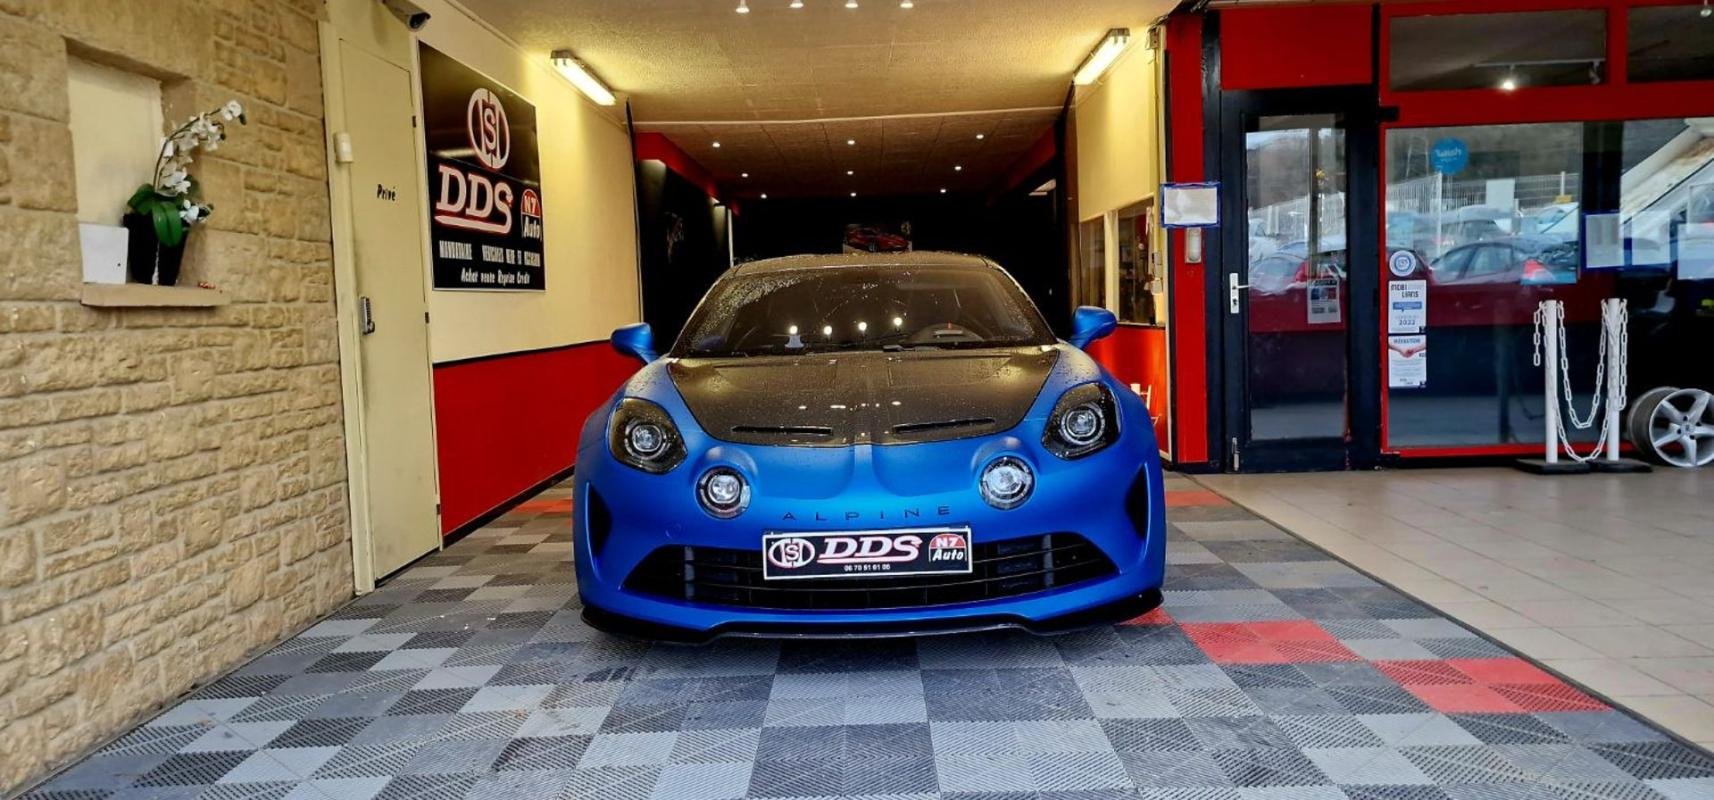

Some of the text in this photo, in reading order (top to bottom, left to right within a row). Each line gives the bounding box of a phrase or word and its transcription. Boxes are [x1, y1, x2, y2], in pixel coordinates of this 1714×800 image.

[376, 183, 396, 202] Privé
[435, 164, 514, 232] DDS
[524, 194, 537, 214] N7
[523, 215, 540, 239] Auto
[782, 505, 951, 521] ALPINE
[817, 535, 923, 562] DDS
[936, 537, 959, 549] N7
[932, 549, 964, 562] Auto
